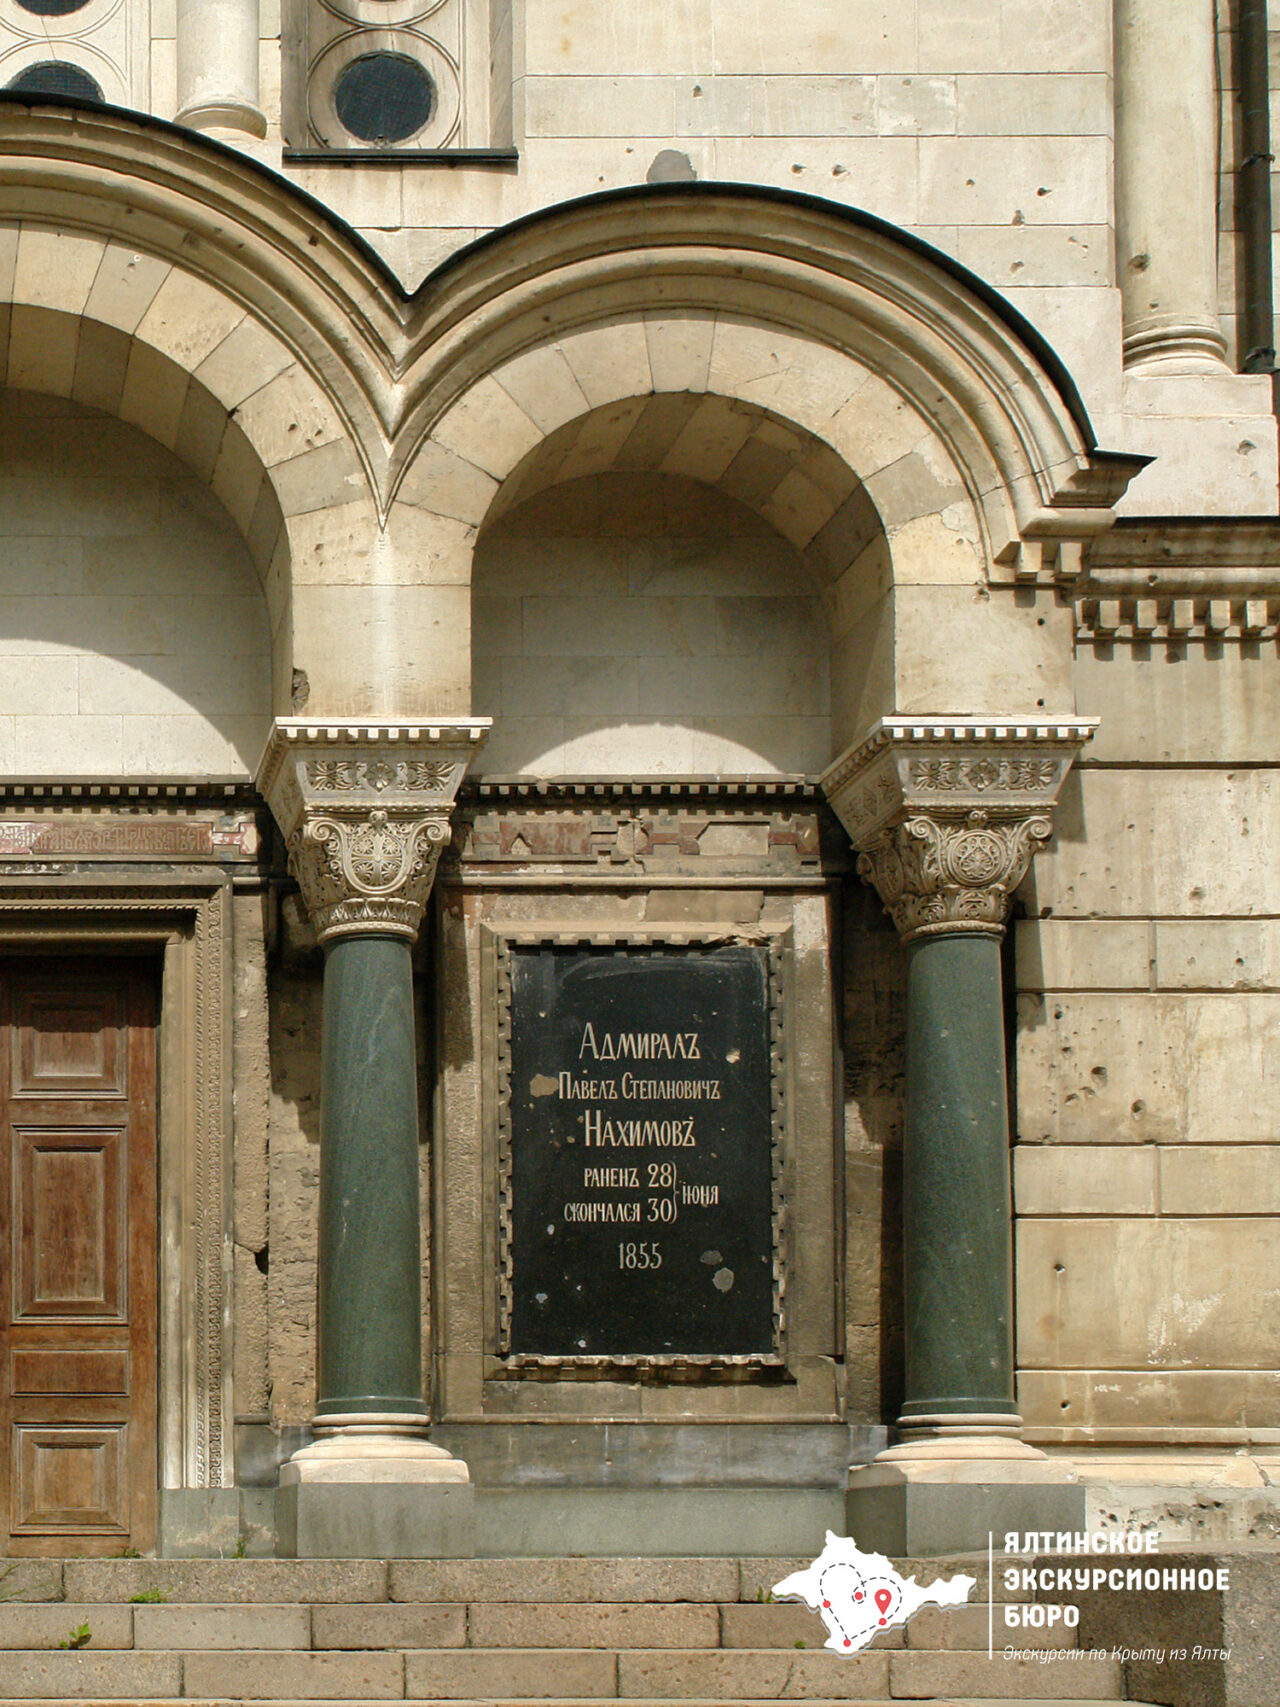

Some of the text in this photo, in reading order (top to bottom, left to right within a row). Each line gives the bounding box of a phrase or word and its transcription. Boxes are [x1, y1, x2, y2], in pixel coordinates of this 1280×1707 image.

[647, 1163, 672, 1188] 28
[646, 1198, 672, 1223] 30
[619, 1243, 662, 1269] 1855
